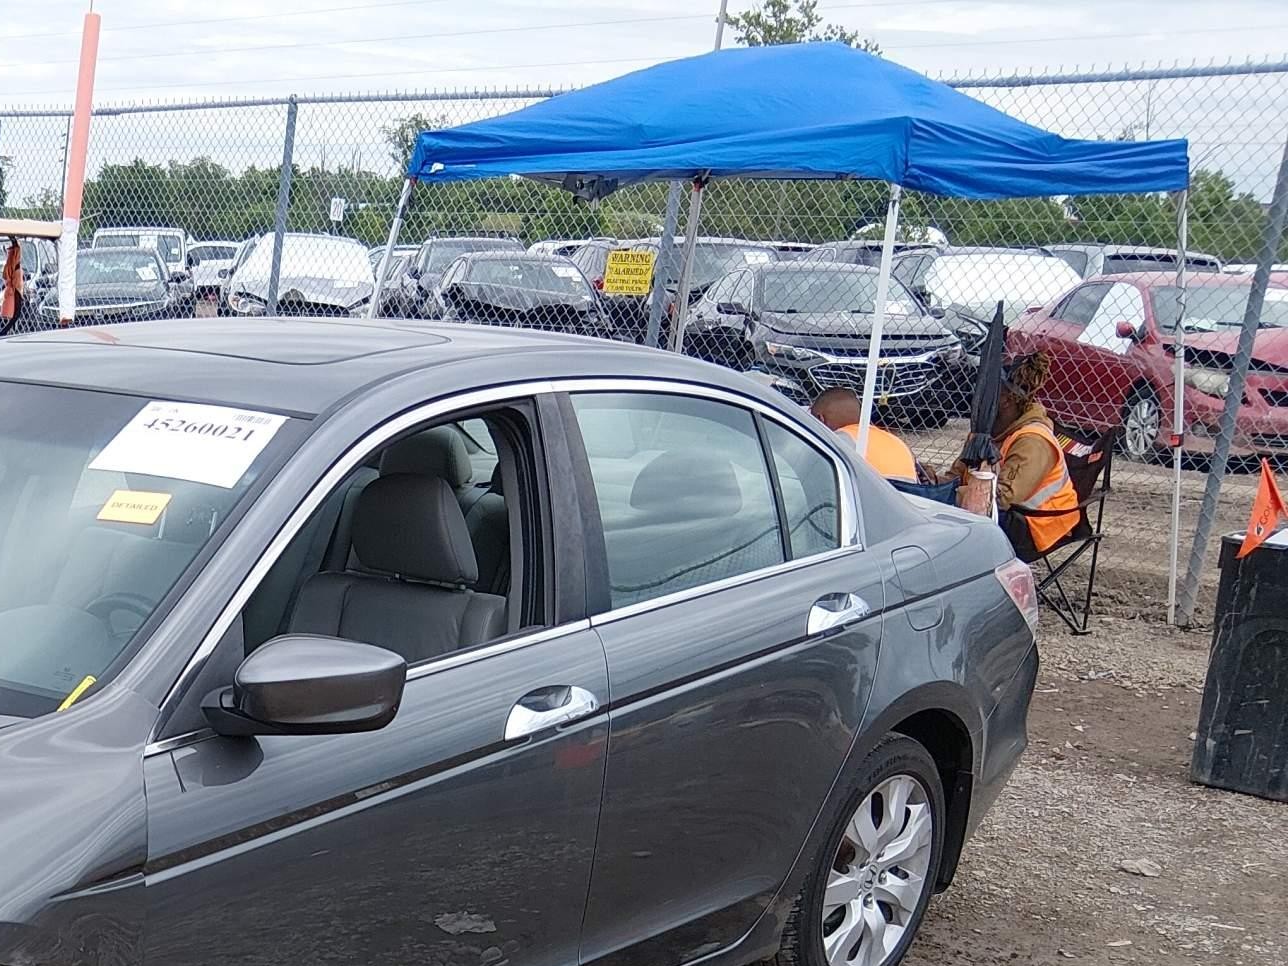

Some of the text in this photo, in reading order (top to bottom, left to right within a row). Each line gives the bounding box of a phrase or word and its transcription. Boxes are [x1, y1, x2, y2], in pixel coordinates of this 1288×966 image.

[611, 253, 651, 263] WARNING
[614, 267, 645, 275] ALARMED
[144, 418, 255, 441] 45260021
[111, 502, 159, 511] DETAILED
